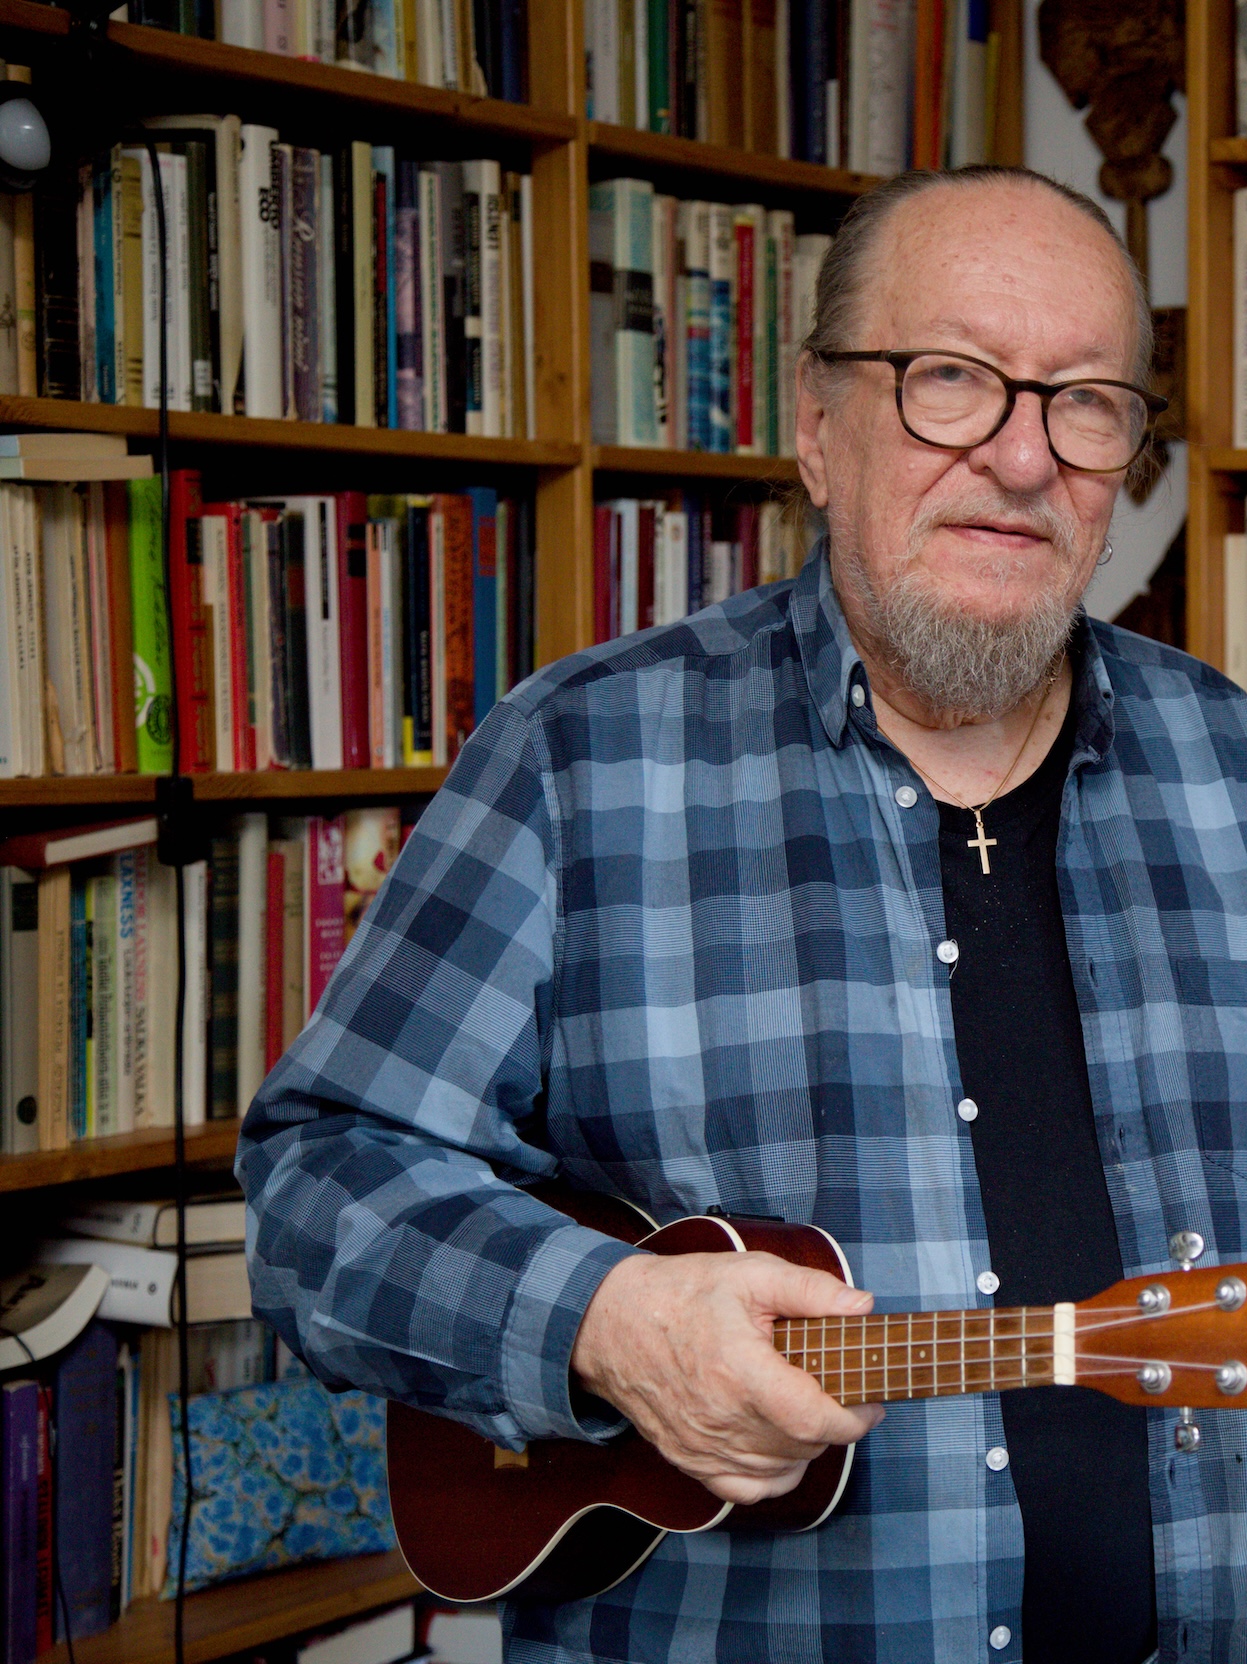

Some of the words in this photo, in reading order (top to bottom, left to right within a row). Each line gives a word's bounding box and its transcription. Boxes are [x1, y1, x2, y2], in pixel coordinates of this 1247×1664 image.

[258, 187, 271, 223] ECO
[269, 139, 281, 230] UMBERTO
[120, 854, 134, 938] LAXNESS
